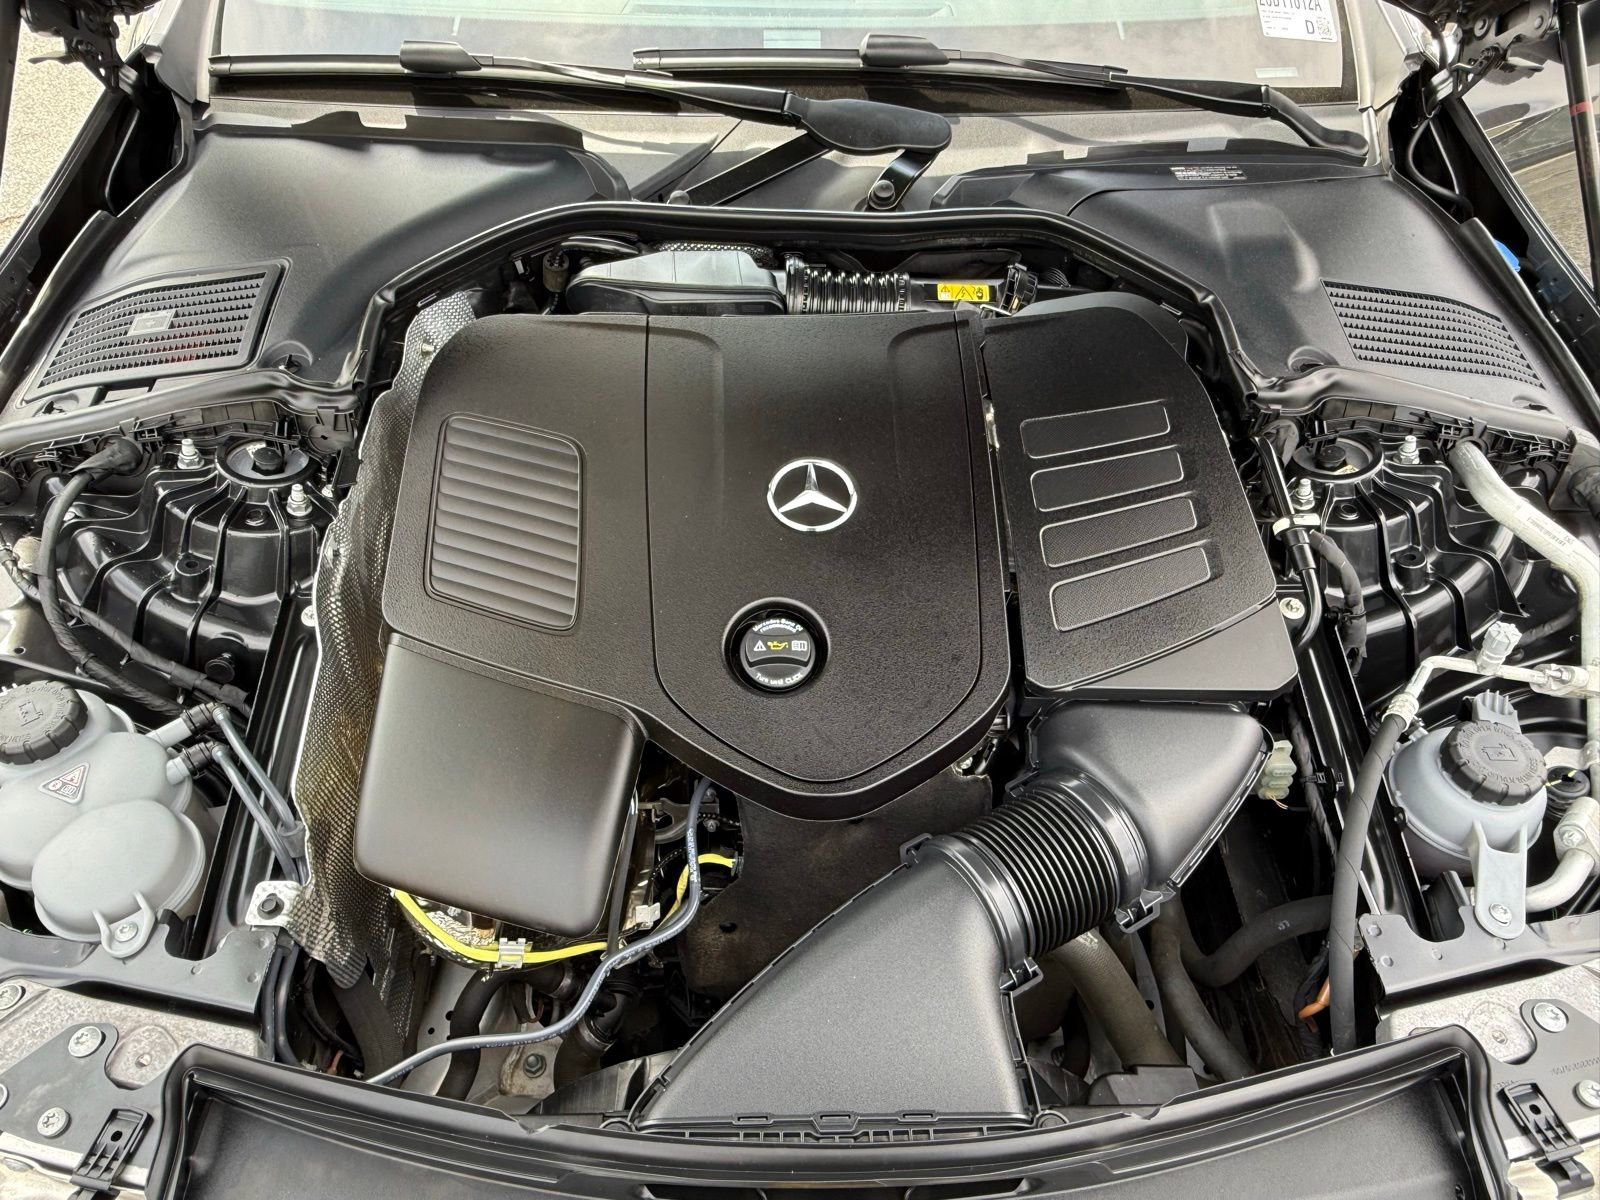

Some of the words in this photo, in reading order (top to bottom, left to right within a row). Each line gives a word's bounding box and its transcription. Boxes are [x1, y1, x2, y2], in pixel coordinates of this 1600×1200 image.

[1305, 20, 1315, 34] D
[755, 672, 769, 683] Turn
[784, 672, 803, 684] CLICK
